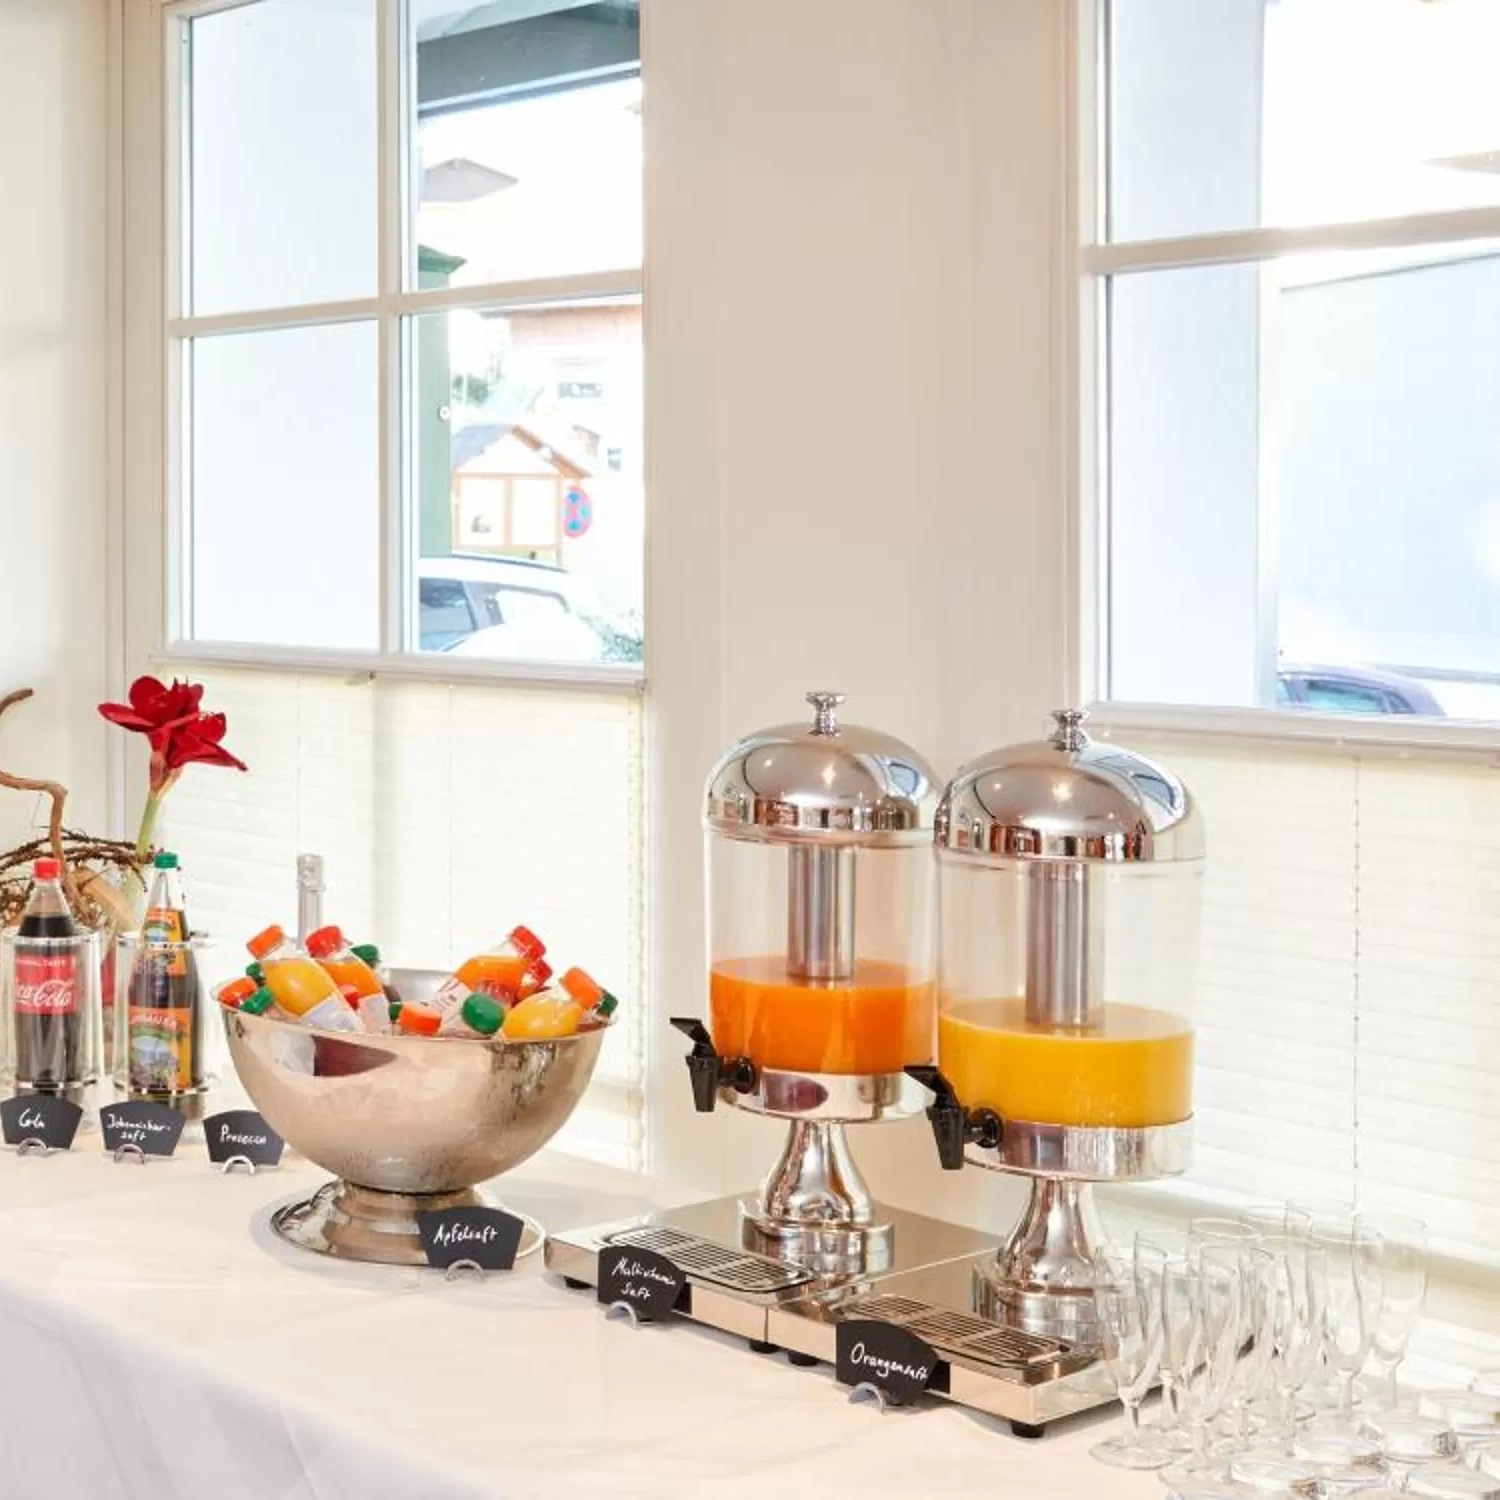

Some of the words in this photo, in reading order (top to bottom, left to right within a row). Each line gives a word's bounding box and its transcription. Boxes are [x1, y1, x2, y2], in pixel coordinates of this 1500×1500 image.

[18, 1107, 46, 1129] Cola
[220, 1123, 268, 1145] Prosecco
[433, 1222, 499, 1247] Apfelsaft
[850, 1341, 929, 1380] Orangensaft
